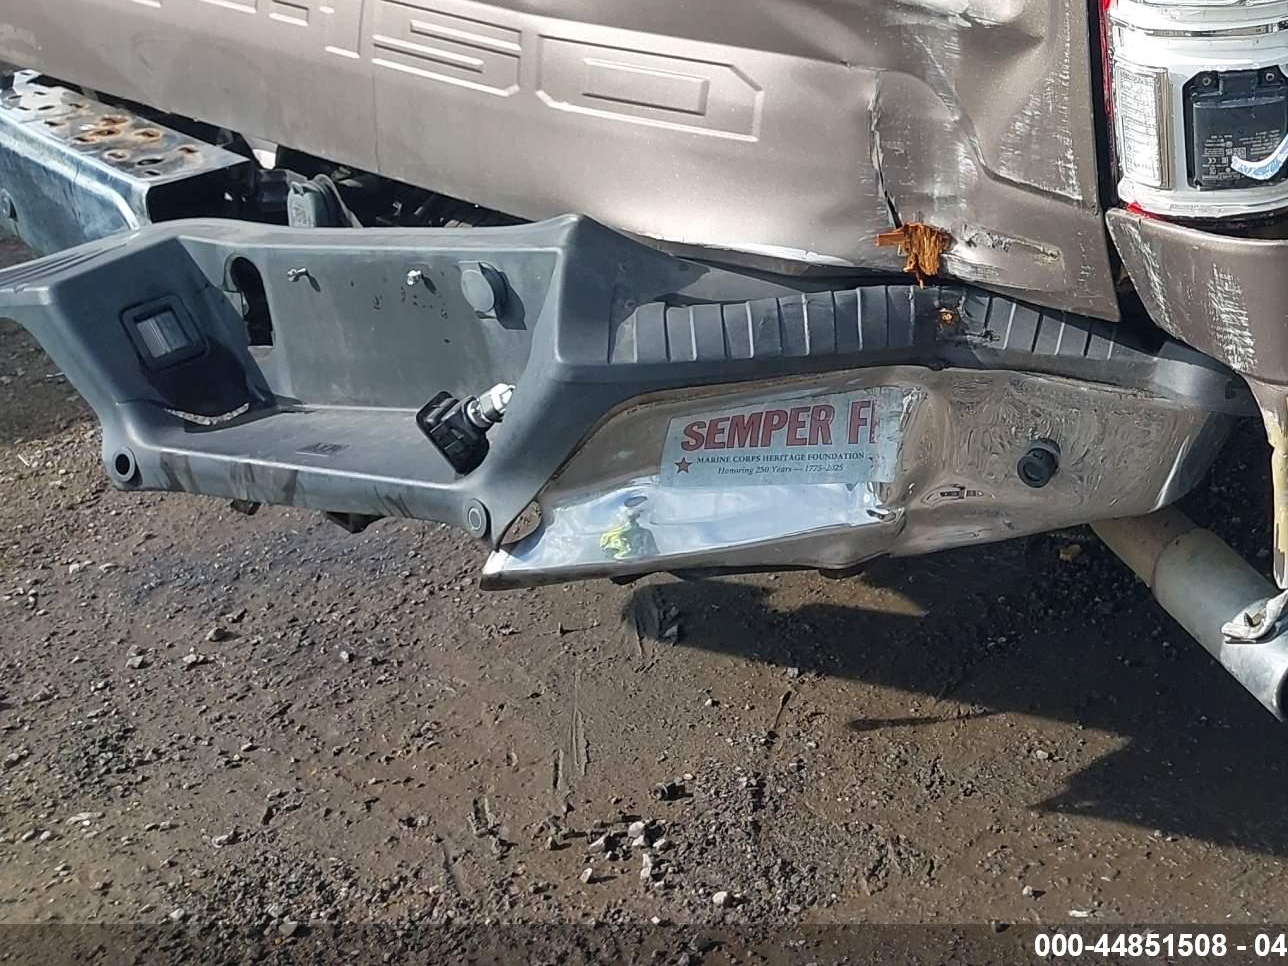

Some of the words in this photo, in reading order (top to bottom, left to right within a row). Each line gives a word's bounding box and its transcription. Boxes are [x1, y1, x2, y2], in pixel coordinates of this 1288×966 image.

[680, 404, 836, 452] SEMPER
[697, 456, 730, 464] MARINE
[732, 454, 761, 463] CORPS
[762, 453, 806, 462] HERITAGE
[807, 451, 865, 461] FOUNDATION
[717, 466, 754, 476] Honoring
[755, 465, 770, 474] 250
[771, 465, 792, 473] Years
